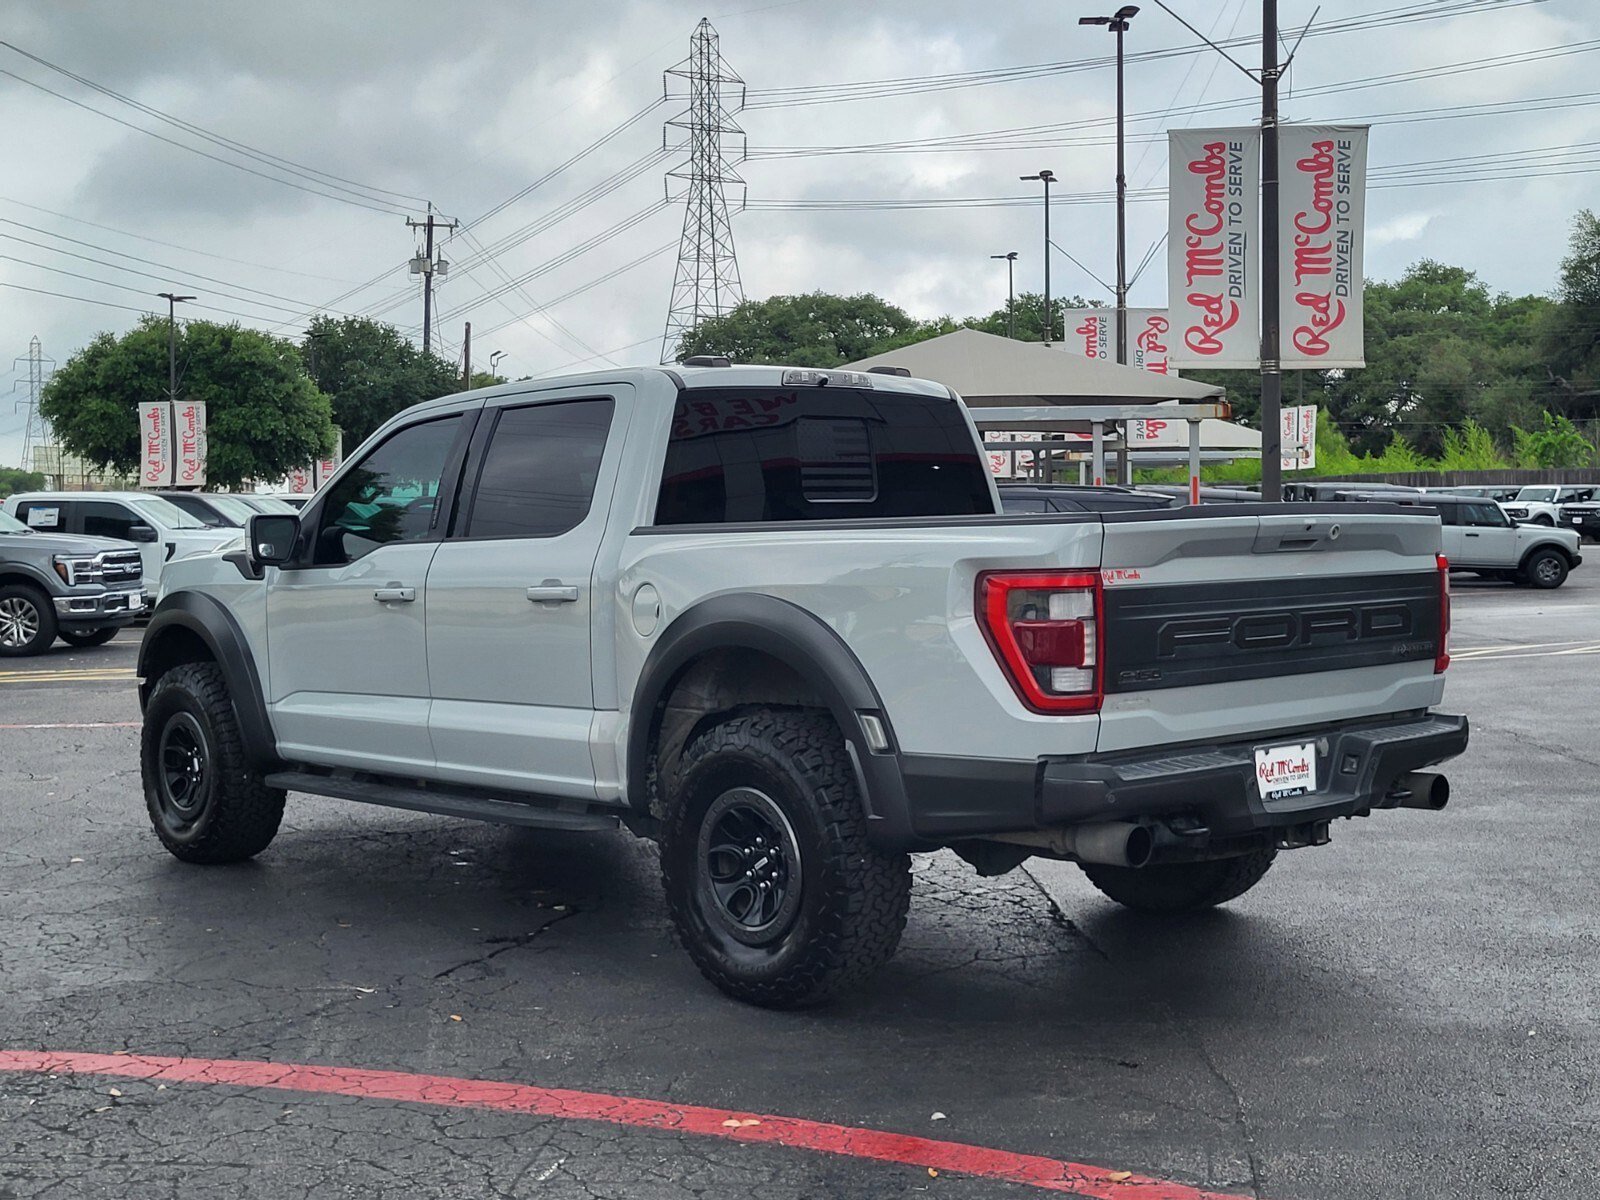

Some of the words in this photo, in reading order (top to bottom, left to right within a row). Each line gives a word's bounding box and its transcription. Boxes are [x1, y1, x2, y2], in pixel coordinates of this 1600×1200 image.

[1228, 141, 1243, 197] SERVE
[1337, 139, 1352, 195] SERVE
[1185, 141, 1227, 287] McCombs
[1228, 202, 1243, 226] TO
[1293, 140, 1335, 287] McCombs
[1336, 200, 1351, 225] TO
[1228, 232, 1243, 298] DRIVEN
[1335, 231, 1350, 298] DRIVEN
[1075, 316, 1098, 359] ombs
[1098, 316, 1108, 348] SERVE
[1137, 316, 1170, 353] Red
[1184, 292, 1240, 355] Red
[1292, 291, 1346, 356] Red
[1098, 350, 1108, 360] O
[1135, 349, 1144, 370] DRI
[146, 460, 165, 482] Red
[182, 459, 201, 481] Red
[1157, 604, 1412, 658] FORD
[1259, 762, 1275, 783] Red
